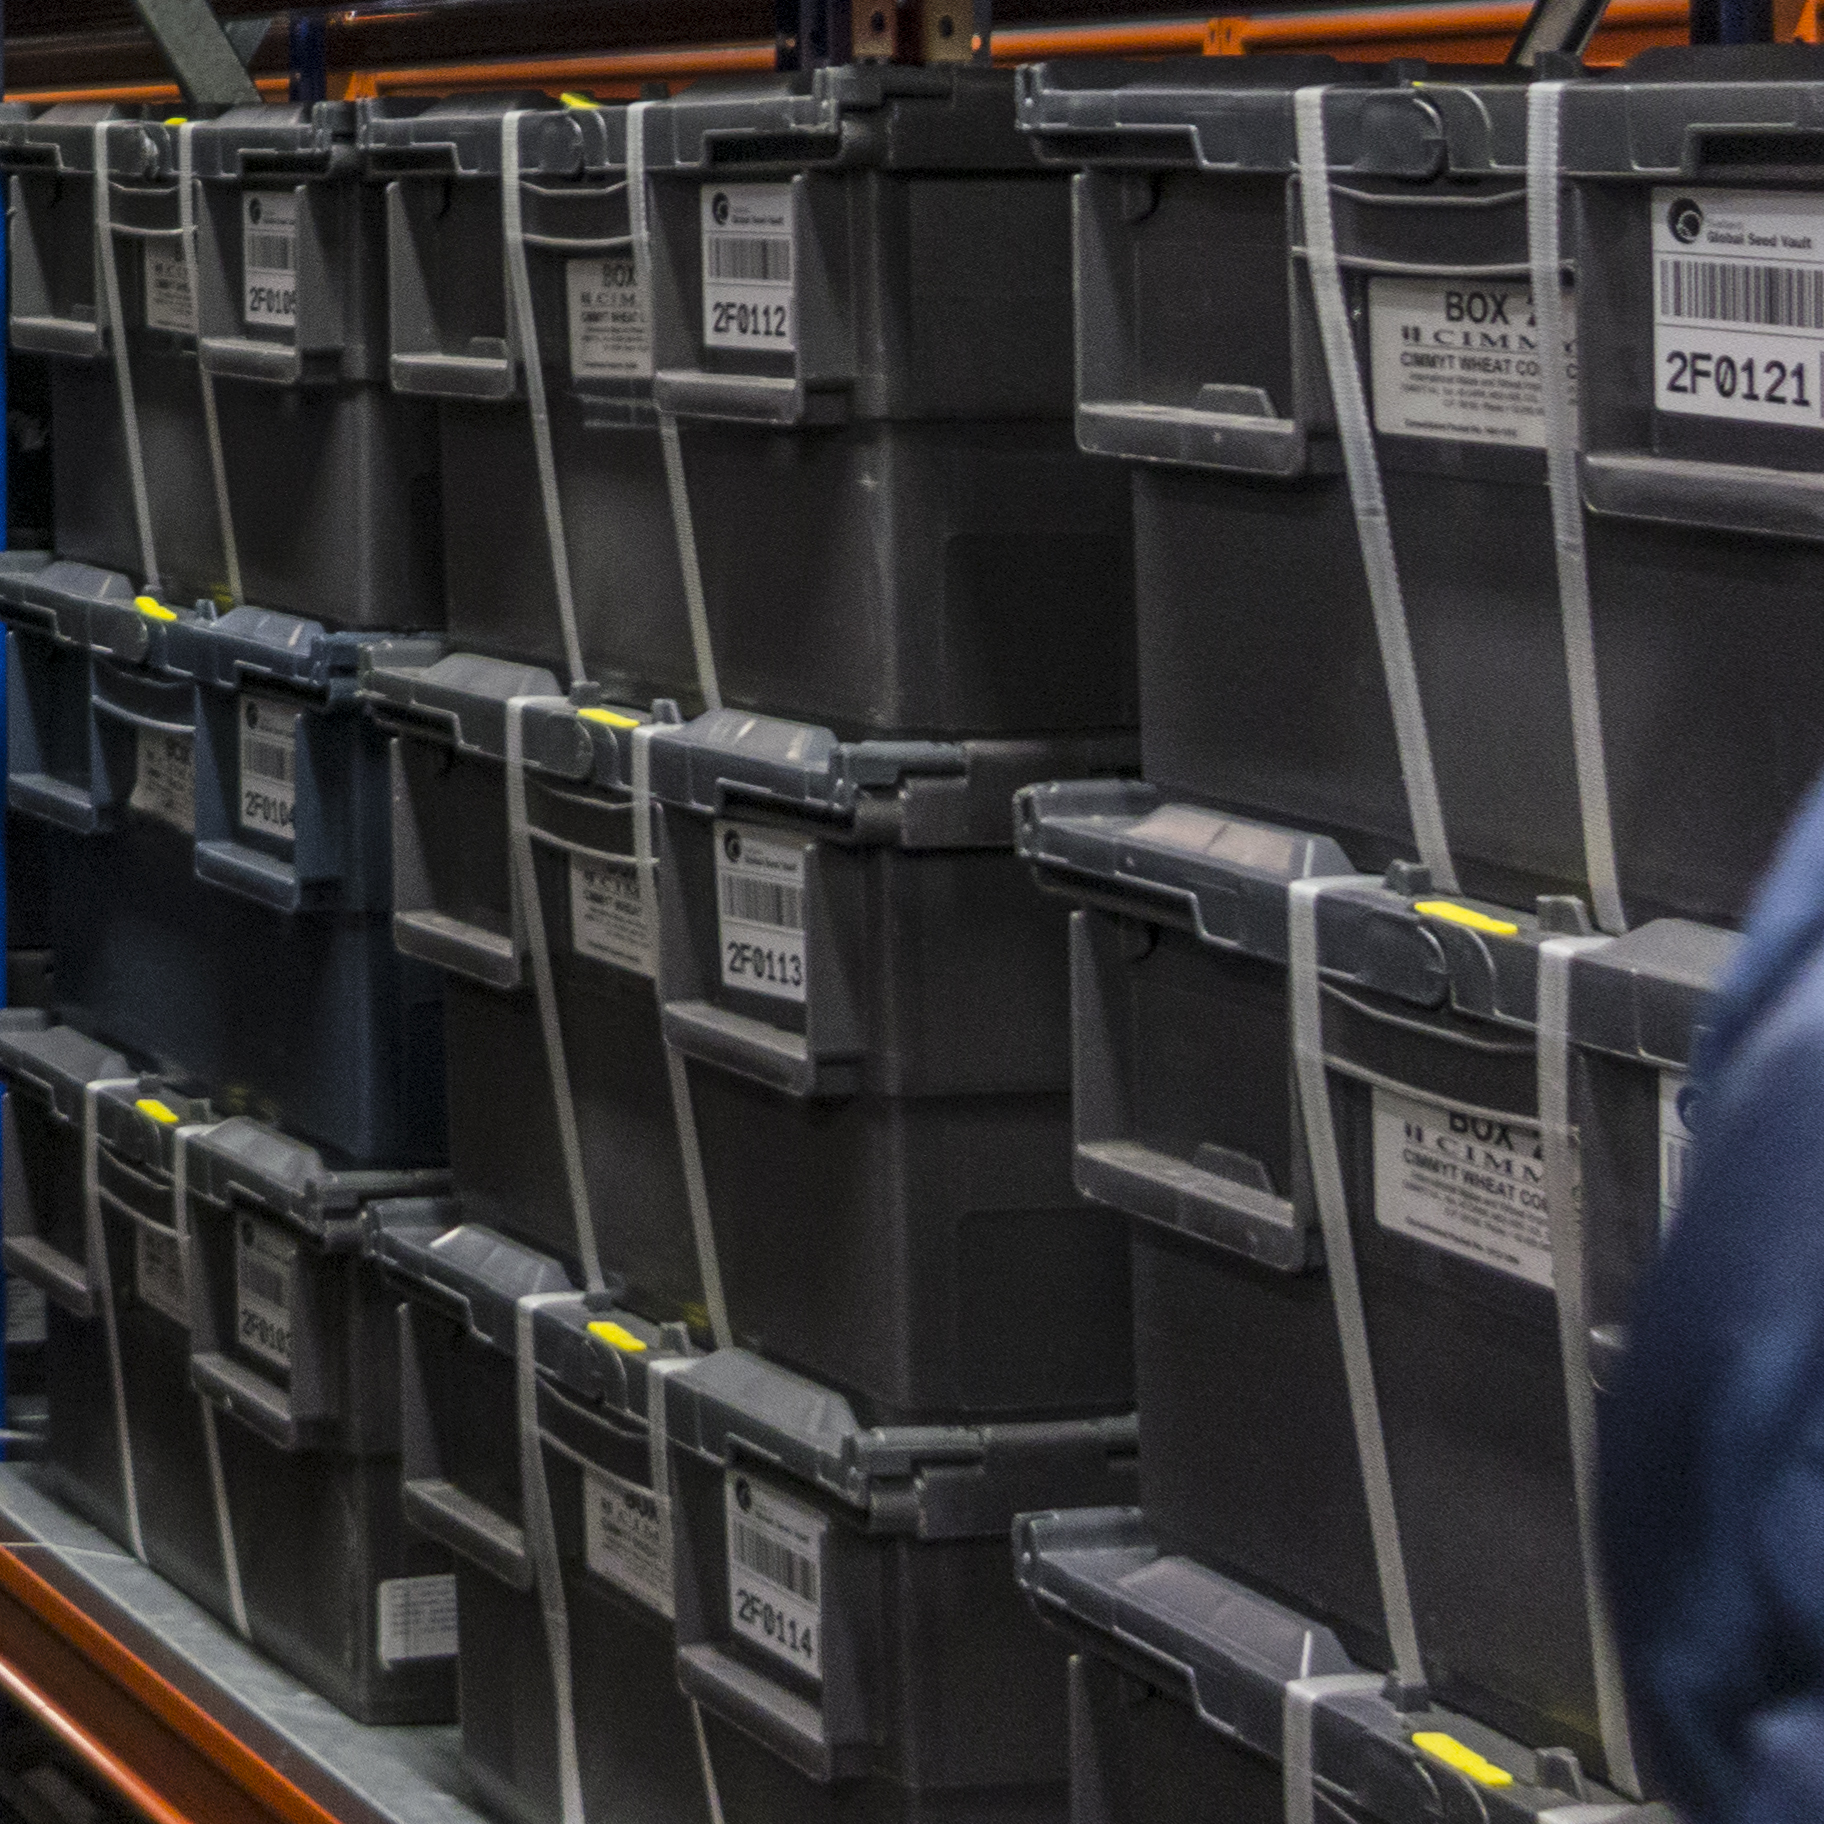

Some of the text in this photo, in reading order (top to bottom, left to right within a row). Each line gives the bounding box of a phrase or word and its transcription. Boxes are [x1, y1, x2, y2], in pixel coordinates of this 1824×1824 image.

[712, 301, 787, 337] 2F0112
[1444, 289, 1510, 326] BOX
[1433, 328, 1538, 351] CIMM
[1400, 350, 1455, 371] CIMMYT
[1458, 353, 1512, 375] WHEAT
[1665, 349, 1811, 408] 2F0121
[726, 940, 802, 987] 2F0113
[1436, 1135, 1543, 1185] CIMM
[736, 1587, 813, 1660] 2F0114
